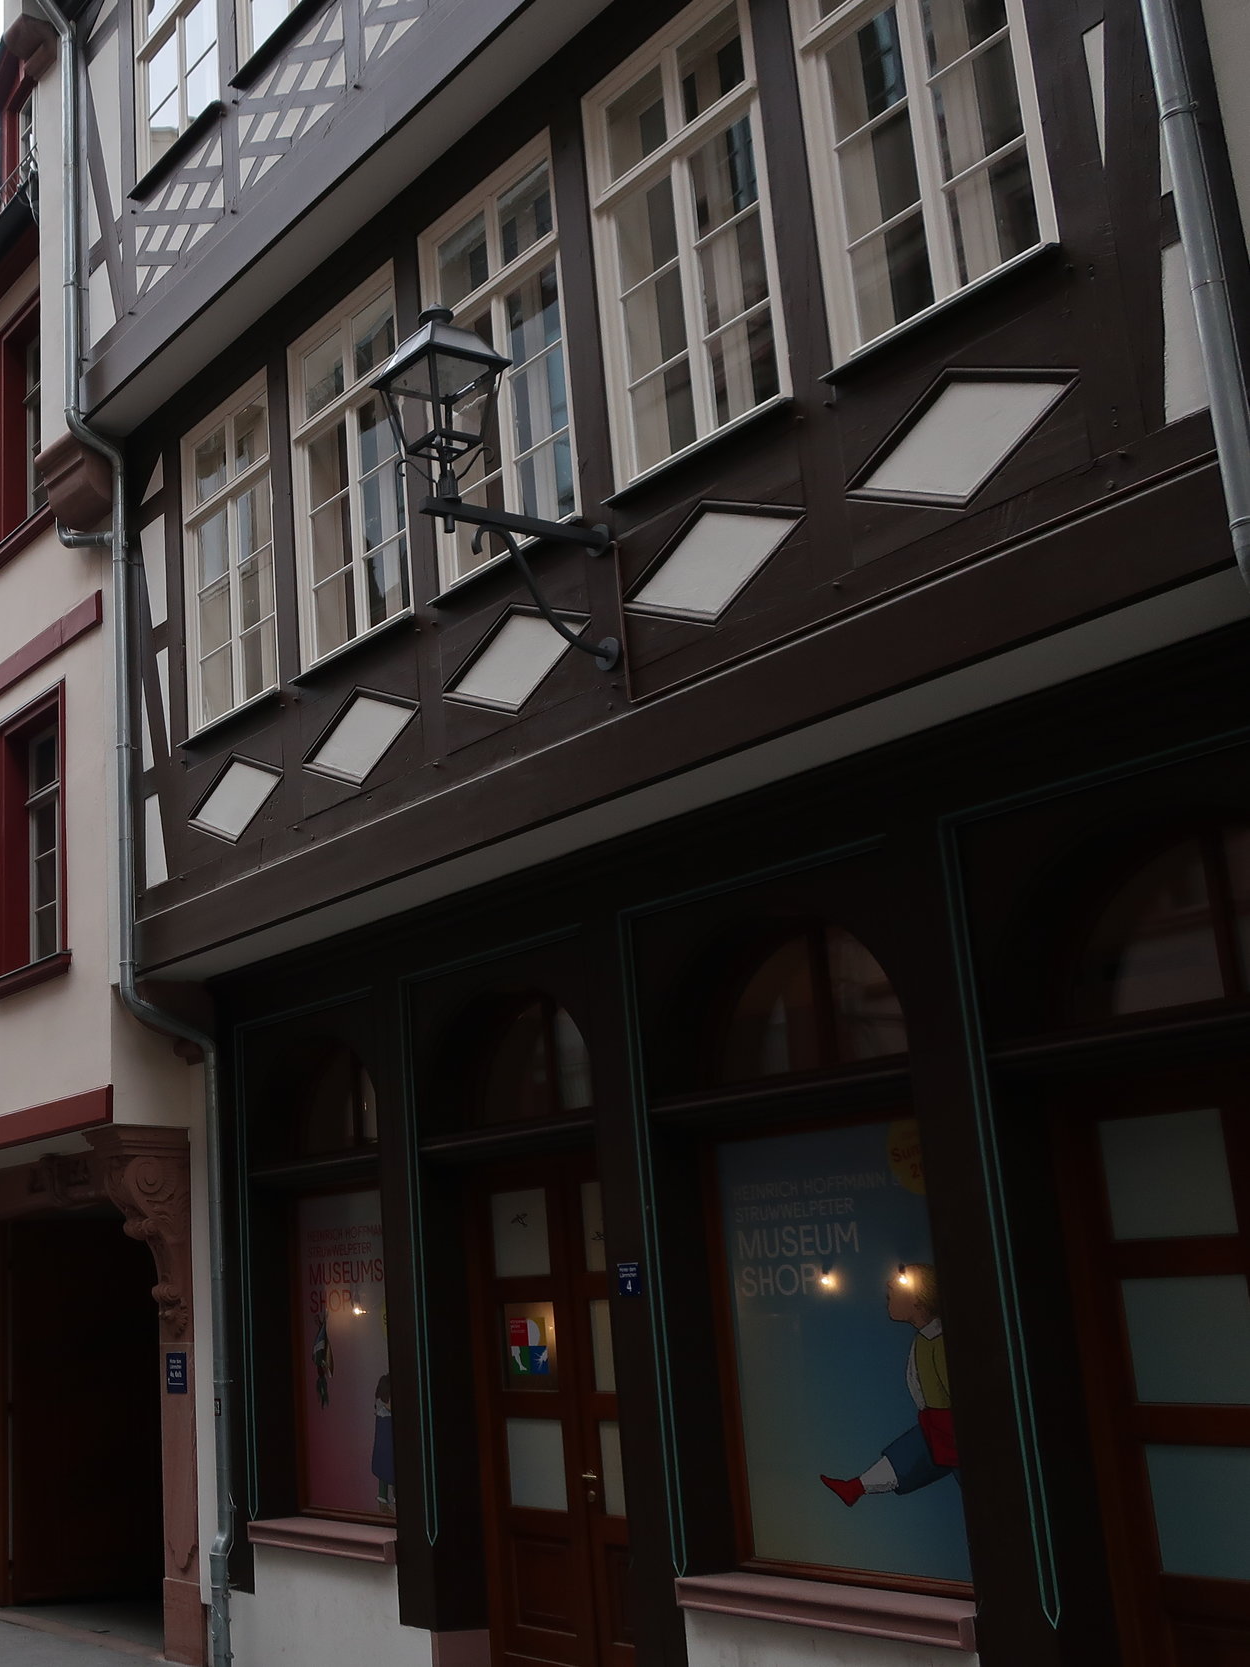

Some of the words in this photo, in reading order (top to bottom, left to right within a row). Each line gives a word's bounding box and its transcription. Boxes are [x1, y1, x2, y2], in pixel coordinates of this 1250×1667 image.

[734, 1181, 798, 1200] HEINRICH
[804, 1172, 886, 1194] HOFFMANN
[735, 1198, 854, 1223] STRUWWELPETER
[308, 1227, 342, 1242] HEINRICH
[736, 1221, 860, 1260] MUSEUM
[308, 1242, 371, 1258] STRUWWELPETER
[310, 1258, 384, 1286] MUSEUMS
[742, 1264, 818, 1297] SHOP
[626, 1279, 632, 1292] 4
[310, 1289, 352, 1313] SHOP
